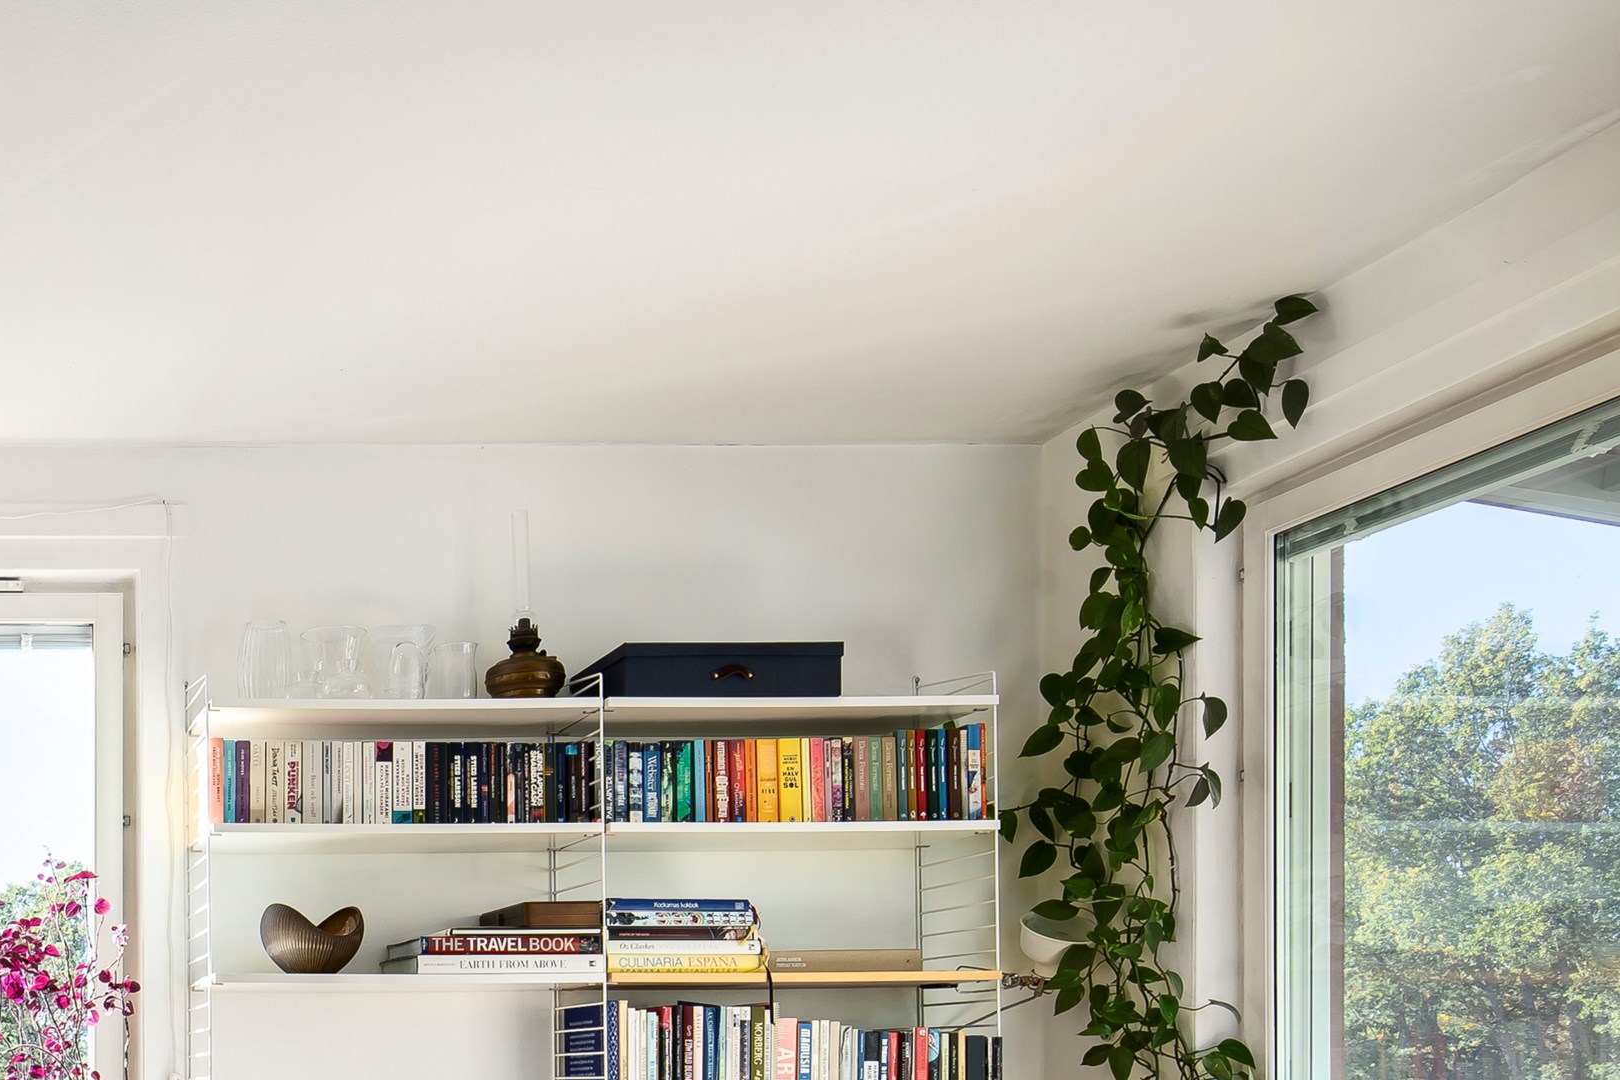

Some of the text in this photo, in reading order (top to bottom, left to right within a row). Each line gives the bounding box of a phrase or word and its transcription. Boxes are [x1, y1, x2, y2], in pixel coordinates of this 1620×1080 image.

[871, 741, 879, 761] Elena
[885, 742, 893, 761] Elena
[536, 751, 544, 806] JENS LAPIDUS
[647, 755, 657, 791] Webster
[680, 901, 699, 909] kokbok
[431, 937, 575, 952] THE TRAVEL BOOK
[459, 959, 567, 969] EARTH FROM ABOVE
[618, 955, 737, 968] CULINARIA ESPAÑA
[754, 1022, 763, 1066] MORBERG
[800, 1028, 811, 1074] MAMUSIA
